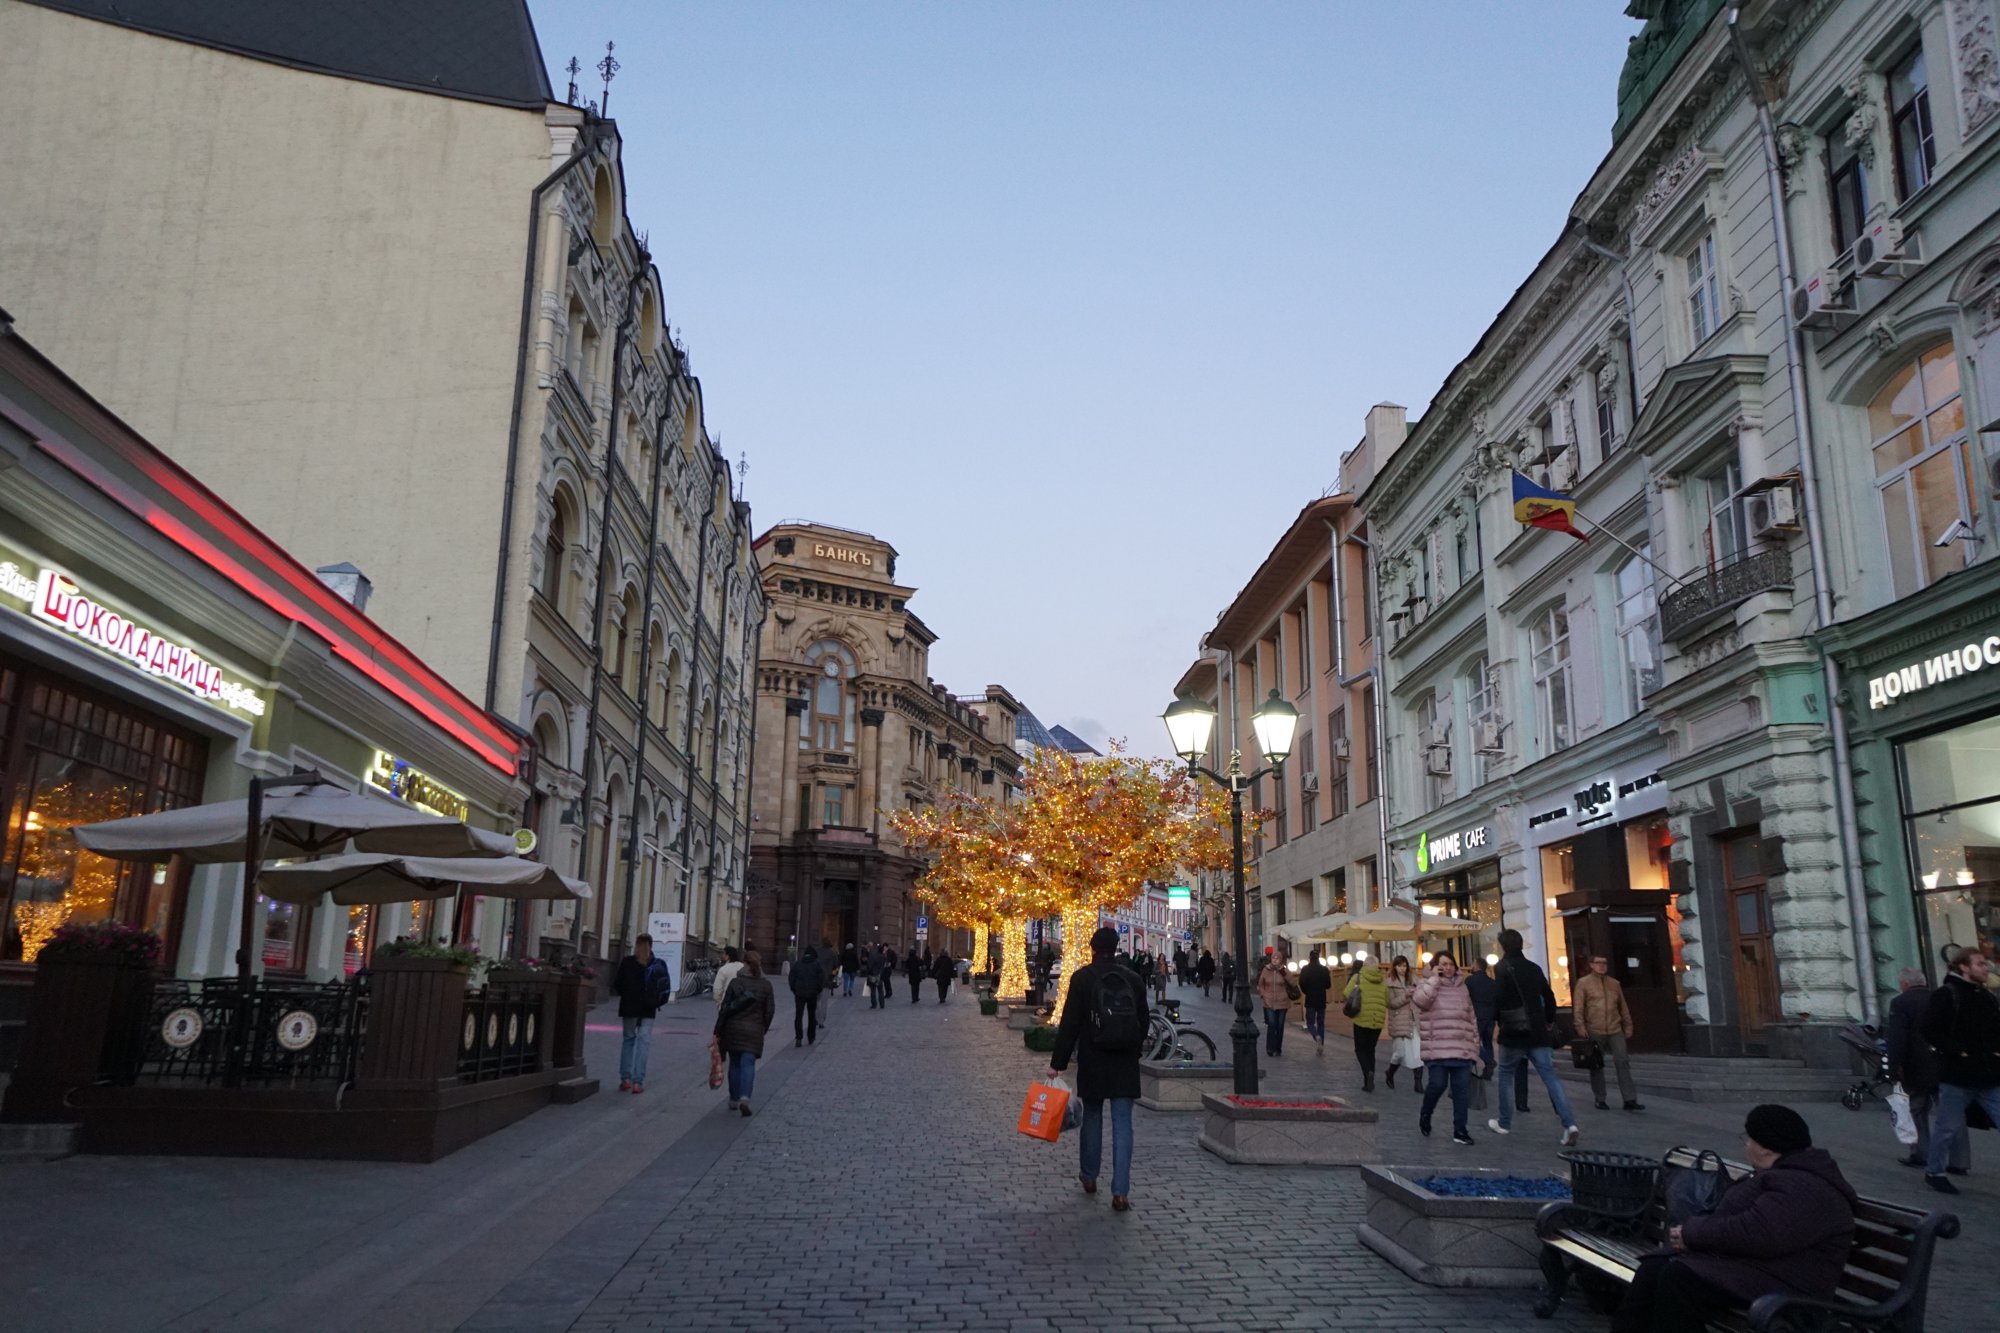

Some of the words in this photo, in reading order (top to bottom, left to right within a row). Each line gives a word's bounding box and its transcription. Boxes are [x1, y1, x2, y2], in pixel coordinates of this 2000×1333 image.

[815, 543, 872, 566] БАНКЪ
[43, 572, 222, 698] ШОКОЛАДНИЦА
[1868, 664, 1922, 710] ДОМ
[1924, 635, 2000, 686] ИНОС
[1429, 832, 1461, 864] PRIME
[1465, 826, 1486, 849] CAFE
[919, 917, 927, 927] P
